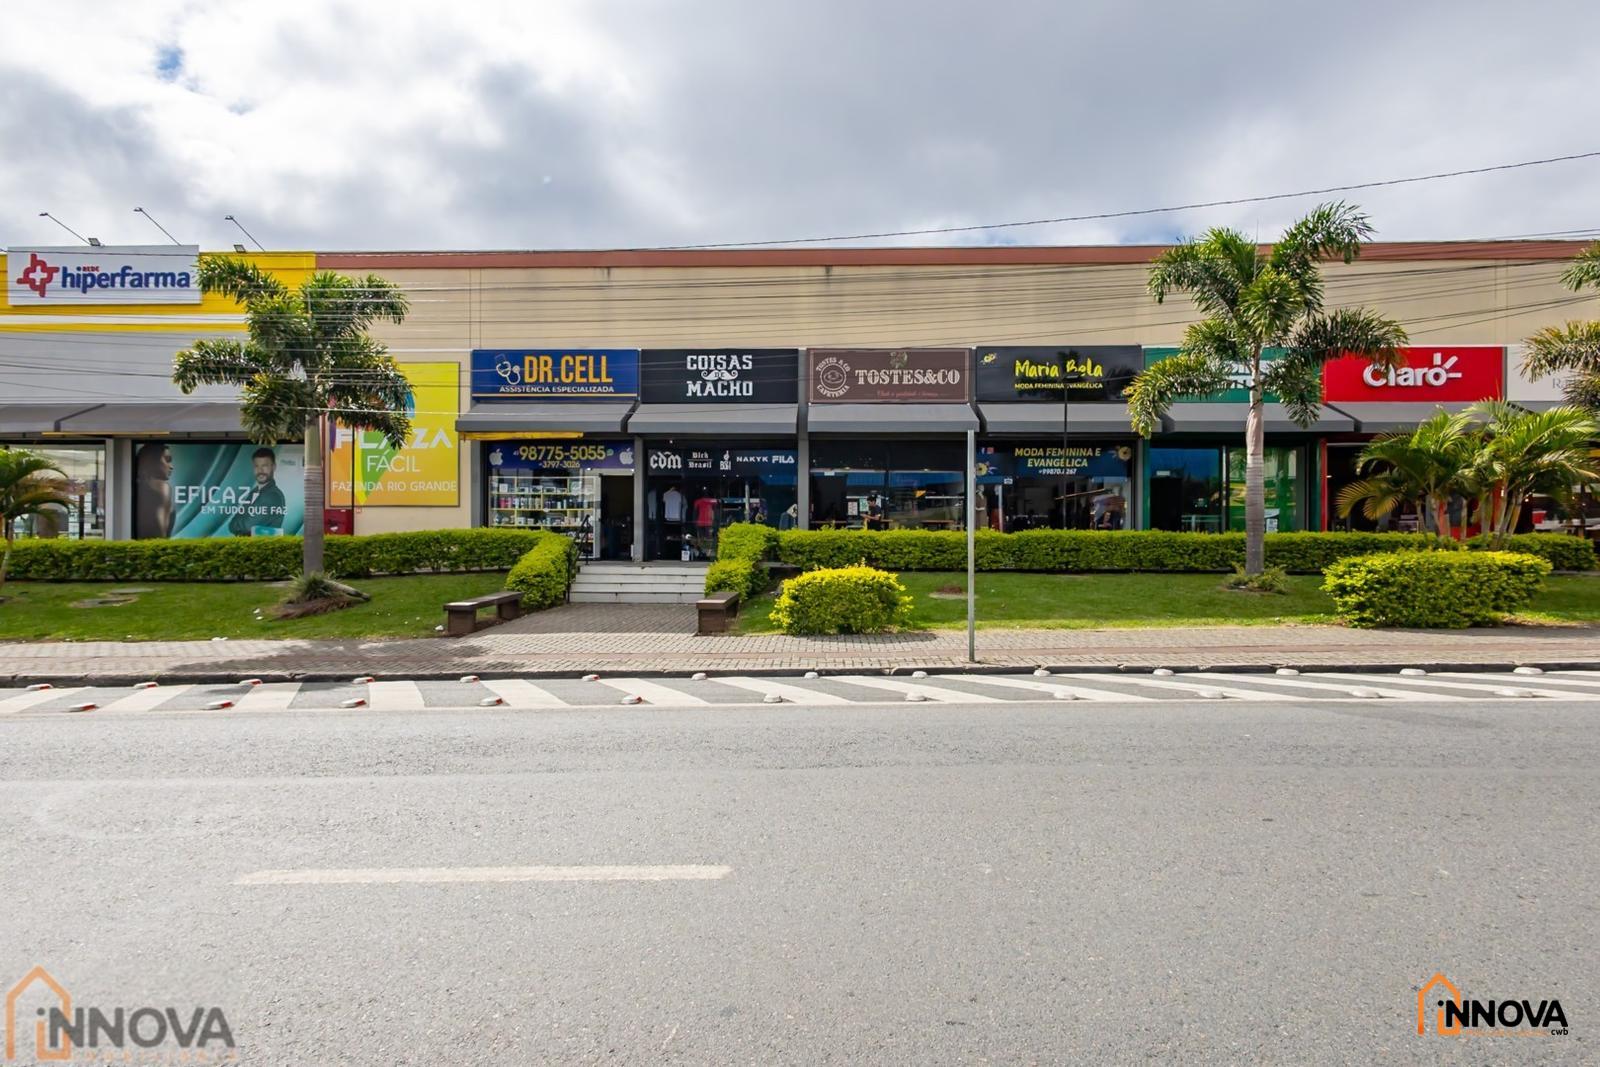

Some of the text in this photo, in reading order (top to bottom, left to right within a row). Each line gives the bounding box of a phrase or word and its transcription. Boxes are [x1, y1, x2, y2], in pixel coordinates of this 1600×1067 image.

[62, 266, 190, 294] hiperfarma
[524, 355, 613, 383] DR.CELL
[686, 355, 753, 370] COISAS
[1015, 360, 1059, 377] Maria
[855, 369, 960, 385] TOSTES&CO
[1363, 360, 1448, 387] Claro
[500, 384, 614, 393] ASSISTÊNCIA ESPECIALIZADA
[686, 381, 753, 396] MACHO
[520, 446, 605, 460] 98775-5055
[772, 455, 795, 464] FILA
[1015, 448, 1101, 457] MODA FEMININA E
[367, 449, 421, 472] FÁCIL
[1027, 457, 1088, 467] EVANGÉLICA
[331, 481, 456, 491] FAZNDA RIO GRANDE
[201, 506, 288, 516] EM TUDO QUE FAZ
